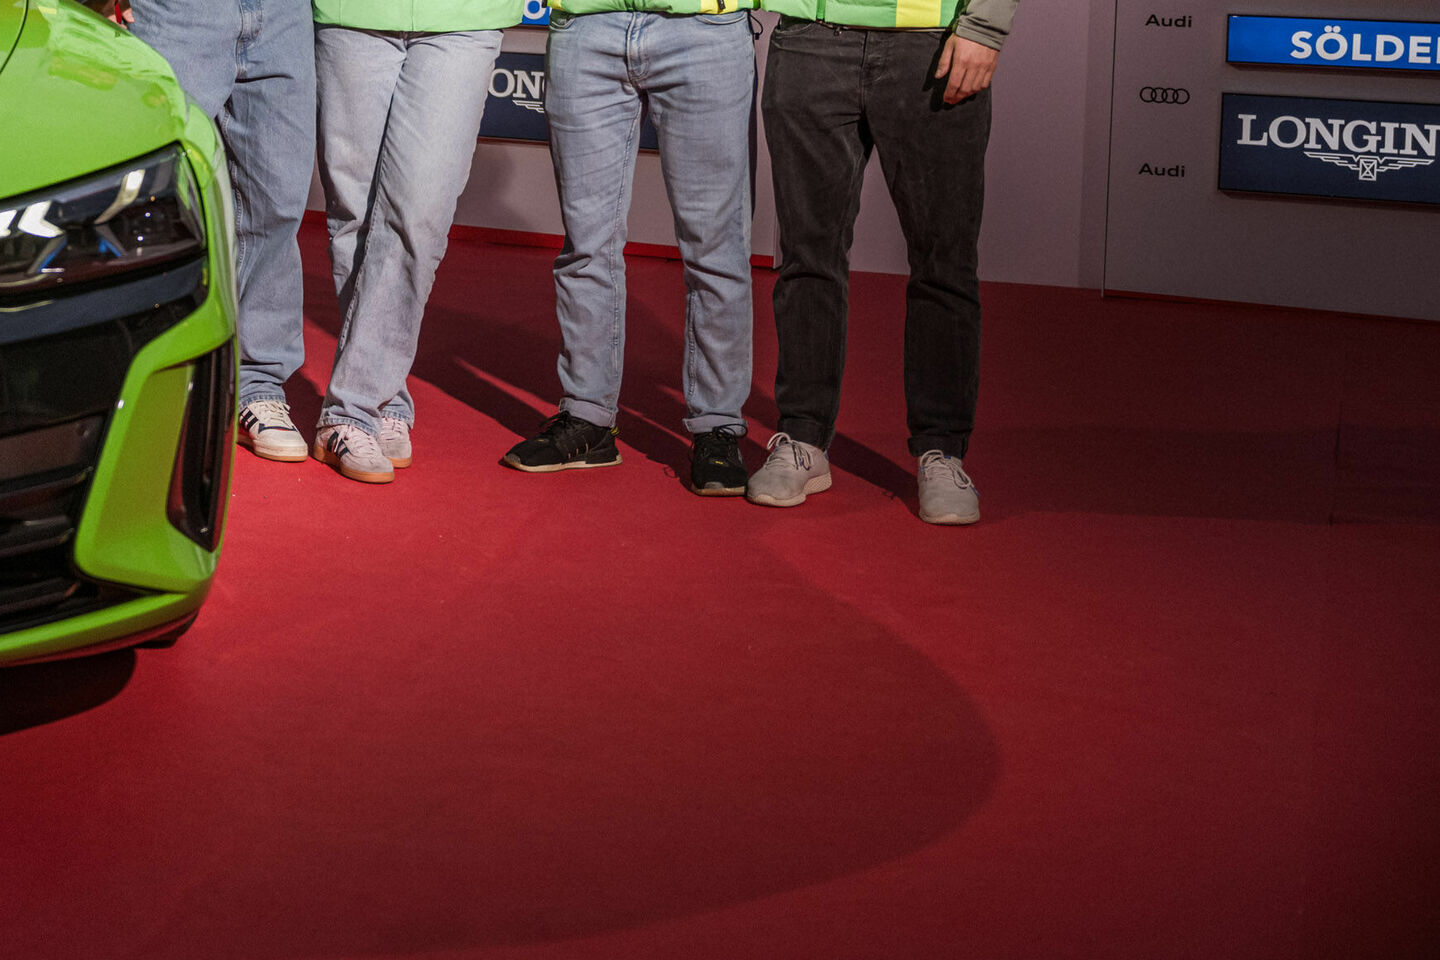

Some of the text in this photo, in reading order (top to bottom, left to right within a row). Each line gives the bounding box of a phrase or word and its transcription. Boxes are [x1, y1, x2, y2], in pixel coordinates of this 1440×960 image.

[1145, 14, 1193, 28] Audi
[1290, 25, 1440, 64] SÖLDE
[1237, 113, 1440, 157] LONGIN
[1138, 163, 1186, 178] Audi
